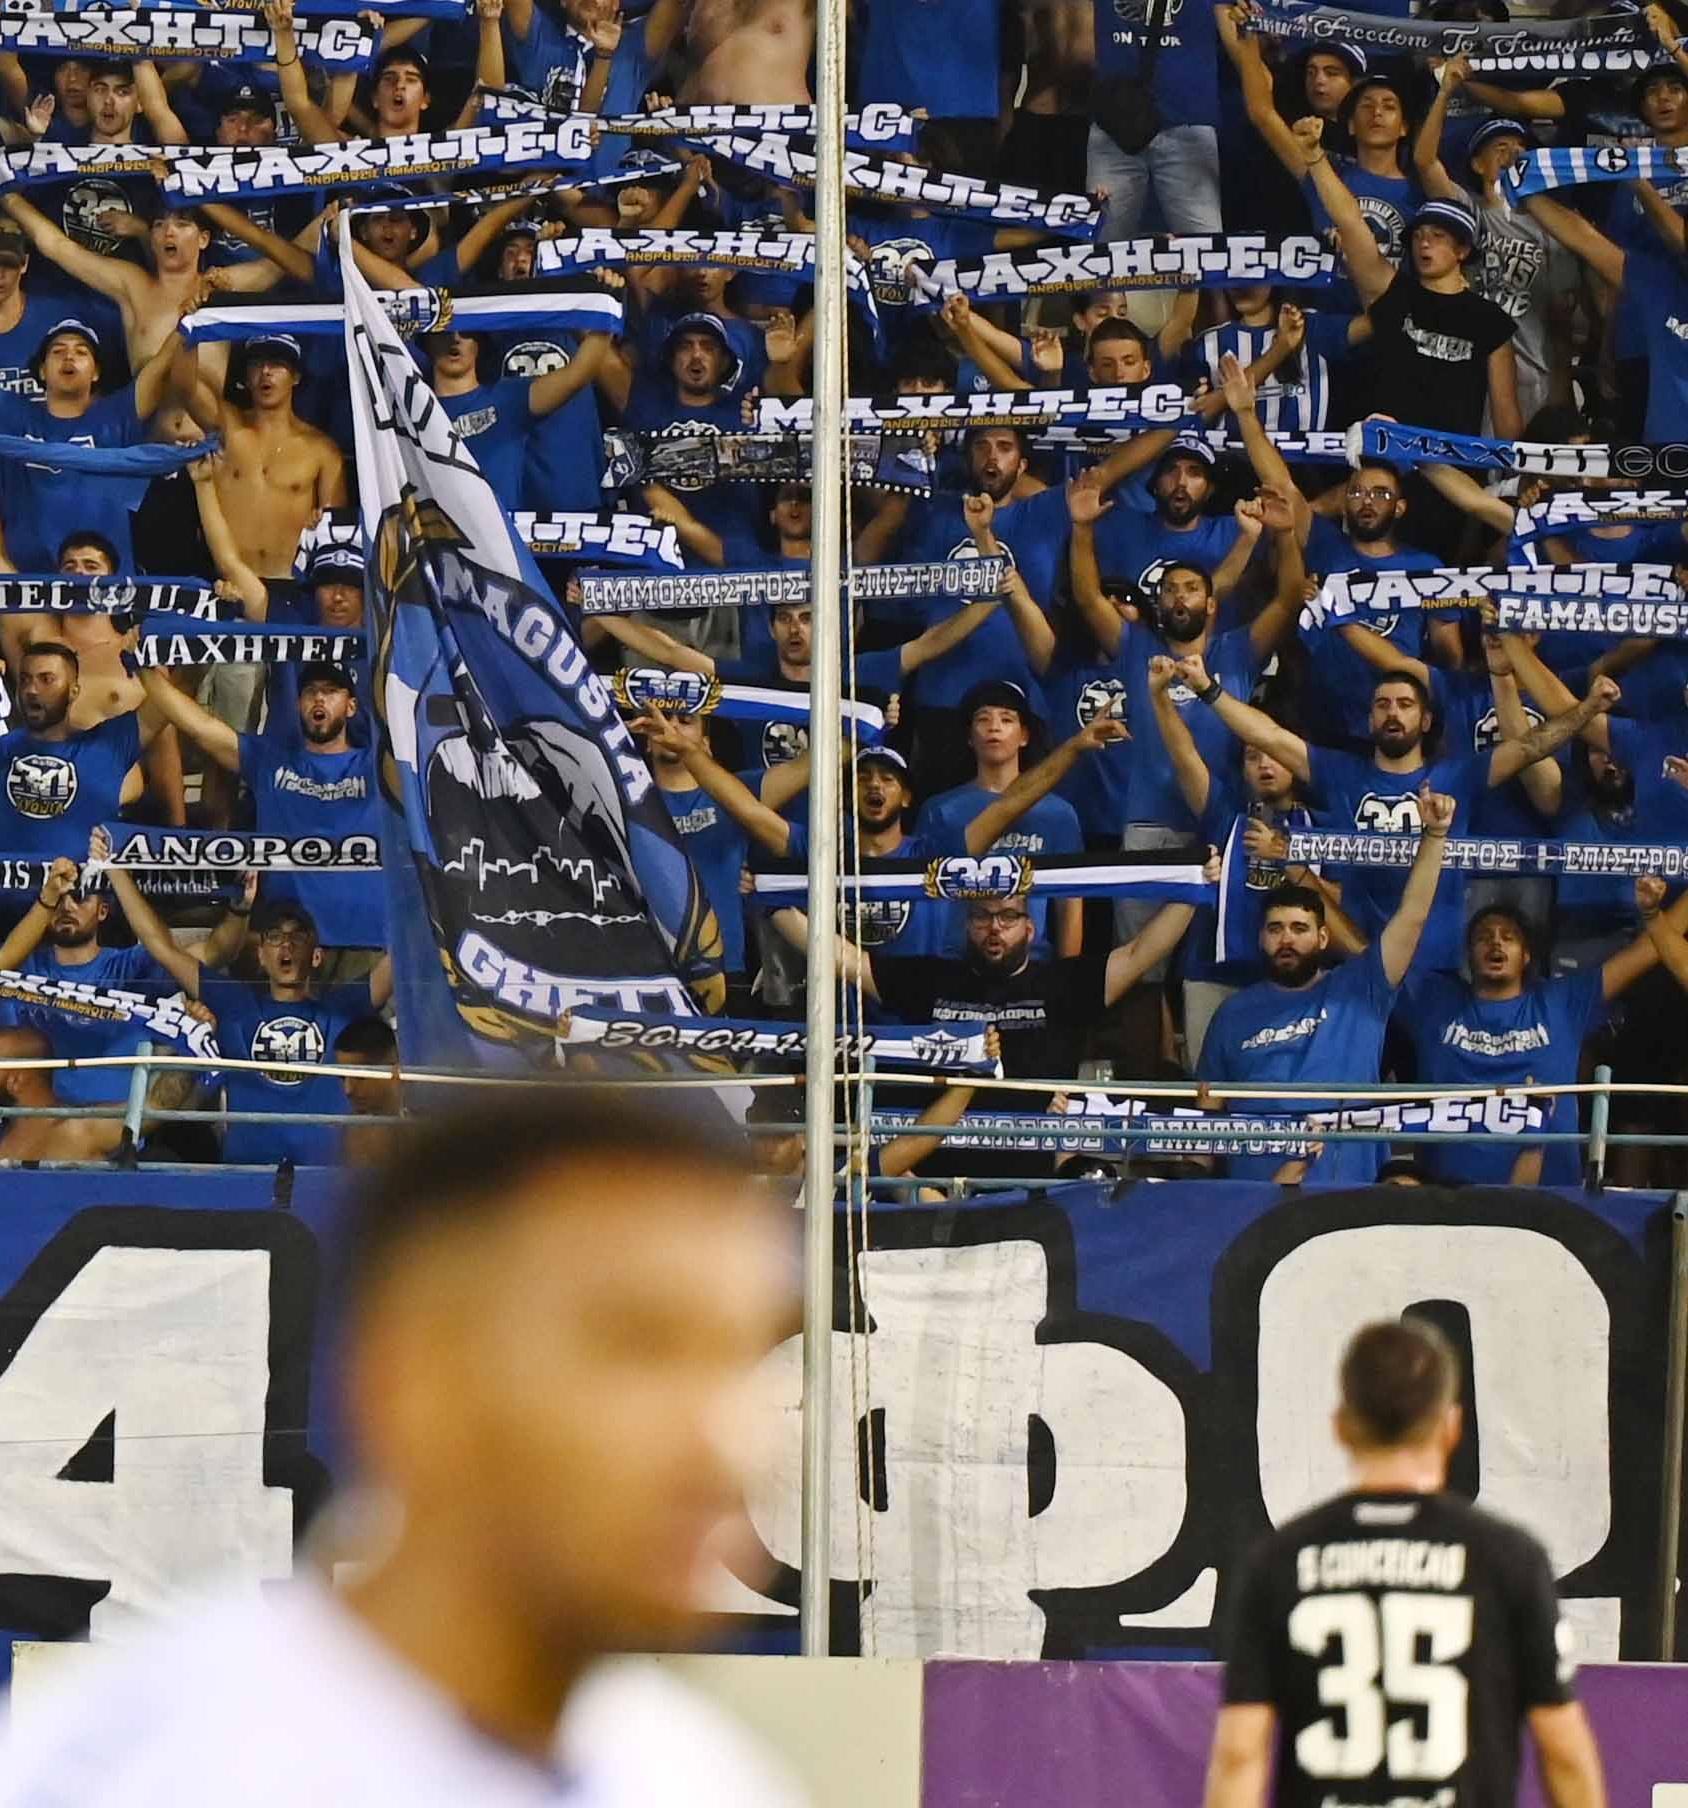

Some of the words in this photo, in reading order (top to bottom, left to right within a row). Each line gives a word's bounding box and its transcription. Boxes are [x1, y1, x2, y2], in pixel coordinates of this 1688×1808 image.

[1139, 34, 1181, 48] TUR
[1314, 17, 1431, 50] Freedom
[117, 833, 381, 867] ΑΝΟΡΘΩ
[1289, 1598, 1473, 1781] 35
